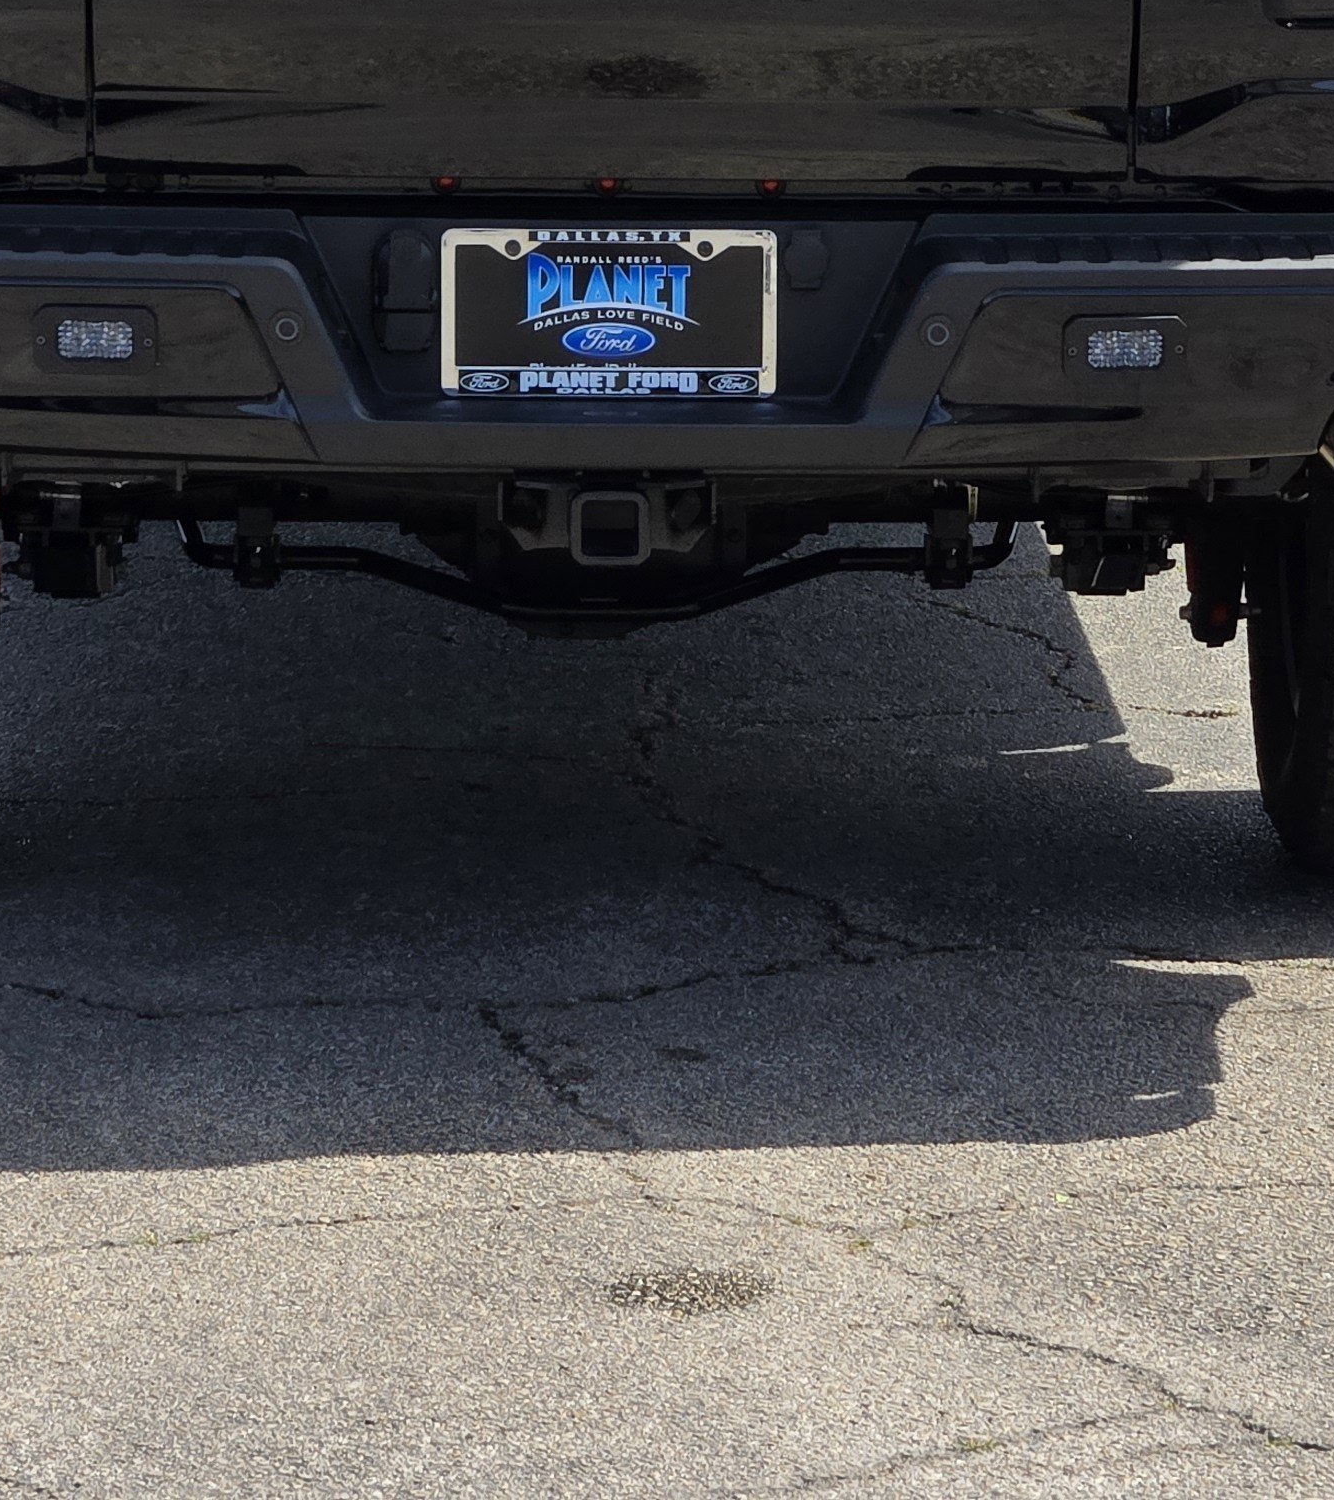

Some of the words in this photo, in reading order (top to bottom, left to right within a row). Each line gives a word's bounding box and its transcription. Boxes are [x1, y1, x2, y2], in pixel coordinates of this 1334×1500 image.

[651, 231, 681, 241] TX
[556, 255, 612, 264] RANDALL
[618, 255, 663, 264] REED'S
[527, 253, 691, 319] PLANET
[533, 310, 590, 331] DALLAS
[597, 309, 636, 319] LOVE
[642, 313, 685, 331] FIELD
[579, 327, 638, 352] Ford
[519, 371, 620, 393] PLANET
[627, 372, 699, 393] FORD
